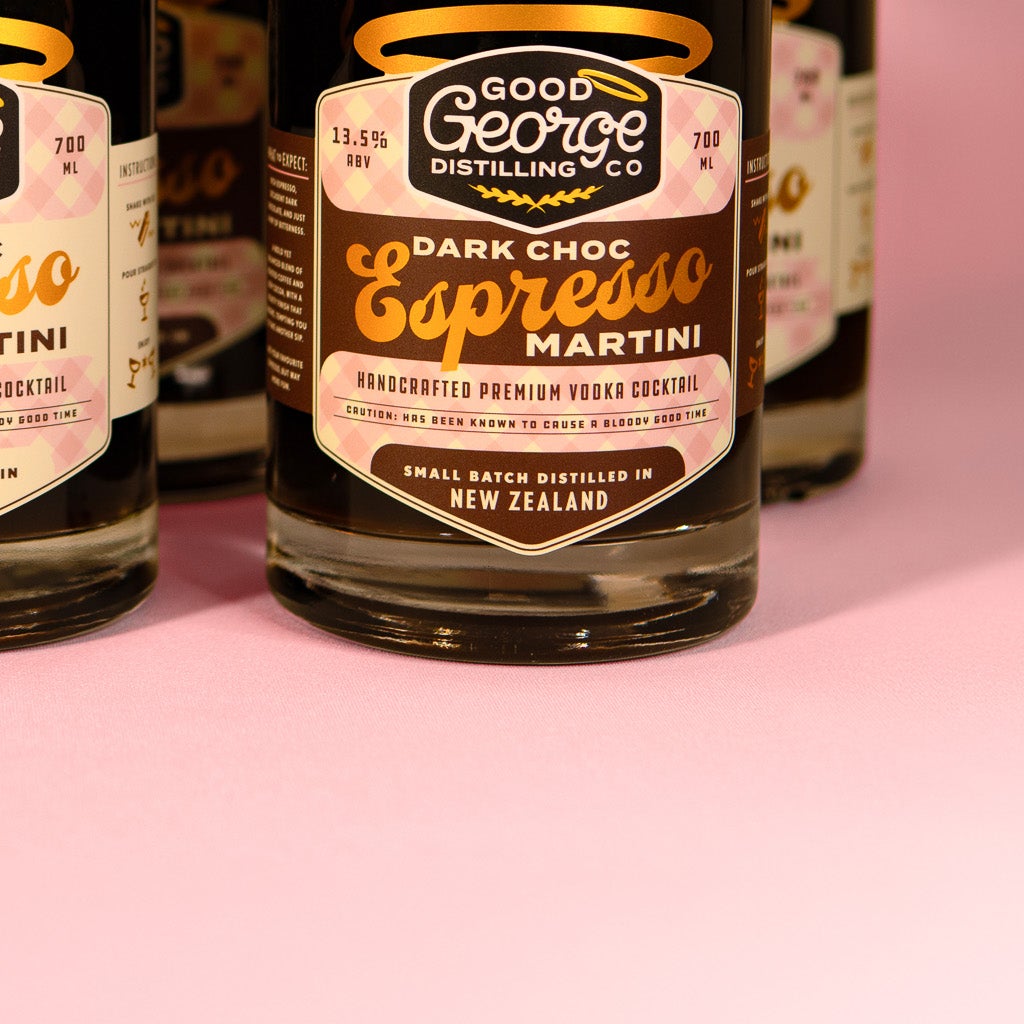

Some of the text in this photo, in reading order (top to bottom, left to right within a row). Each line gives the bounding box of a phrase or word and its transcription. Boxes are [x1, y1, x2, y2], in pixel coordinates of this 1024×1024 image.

[481, 76, 593, 101] GOOD
[331, 126, 388, 149] 13.5%
[423, 84, 649, 170] George
[54, 135, 86, 155] 700
[693, 129, 720, 150] 700
[63, 160, 79, 175] ML
[282, 152, 308, 172] EXPECT:
[347, 152, 371, 169] ABV
[431, 158, 643, 178] DISTILLING CO
[700, 156, 714, 171] ML
[413, 236, 631, 261] DARK CHOC
[345, 240, 714, 372] Espresso
[526, 325, 701, 358] MARTINI
[357, 370, 699, 401] HANDCRAFTED PREMIUM VODKA COCKTAIL
[18, 411, 50, 425] GOOD
[53, 407, 79, 421] TIME
[345, 404, 708, 430] CAUTION: HAS BEEN KNOWN TO CAUSE A BLOODY GOOD TIME
[0, 466, 19, 480] IN
[403, 465, 653, 484] SMALL BATCH DISTILLED IN
[450, 488, 609, 511] NEW ZEALAND
